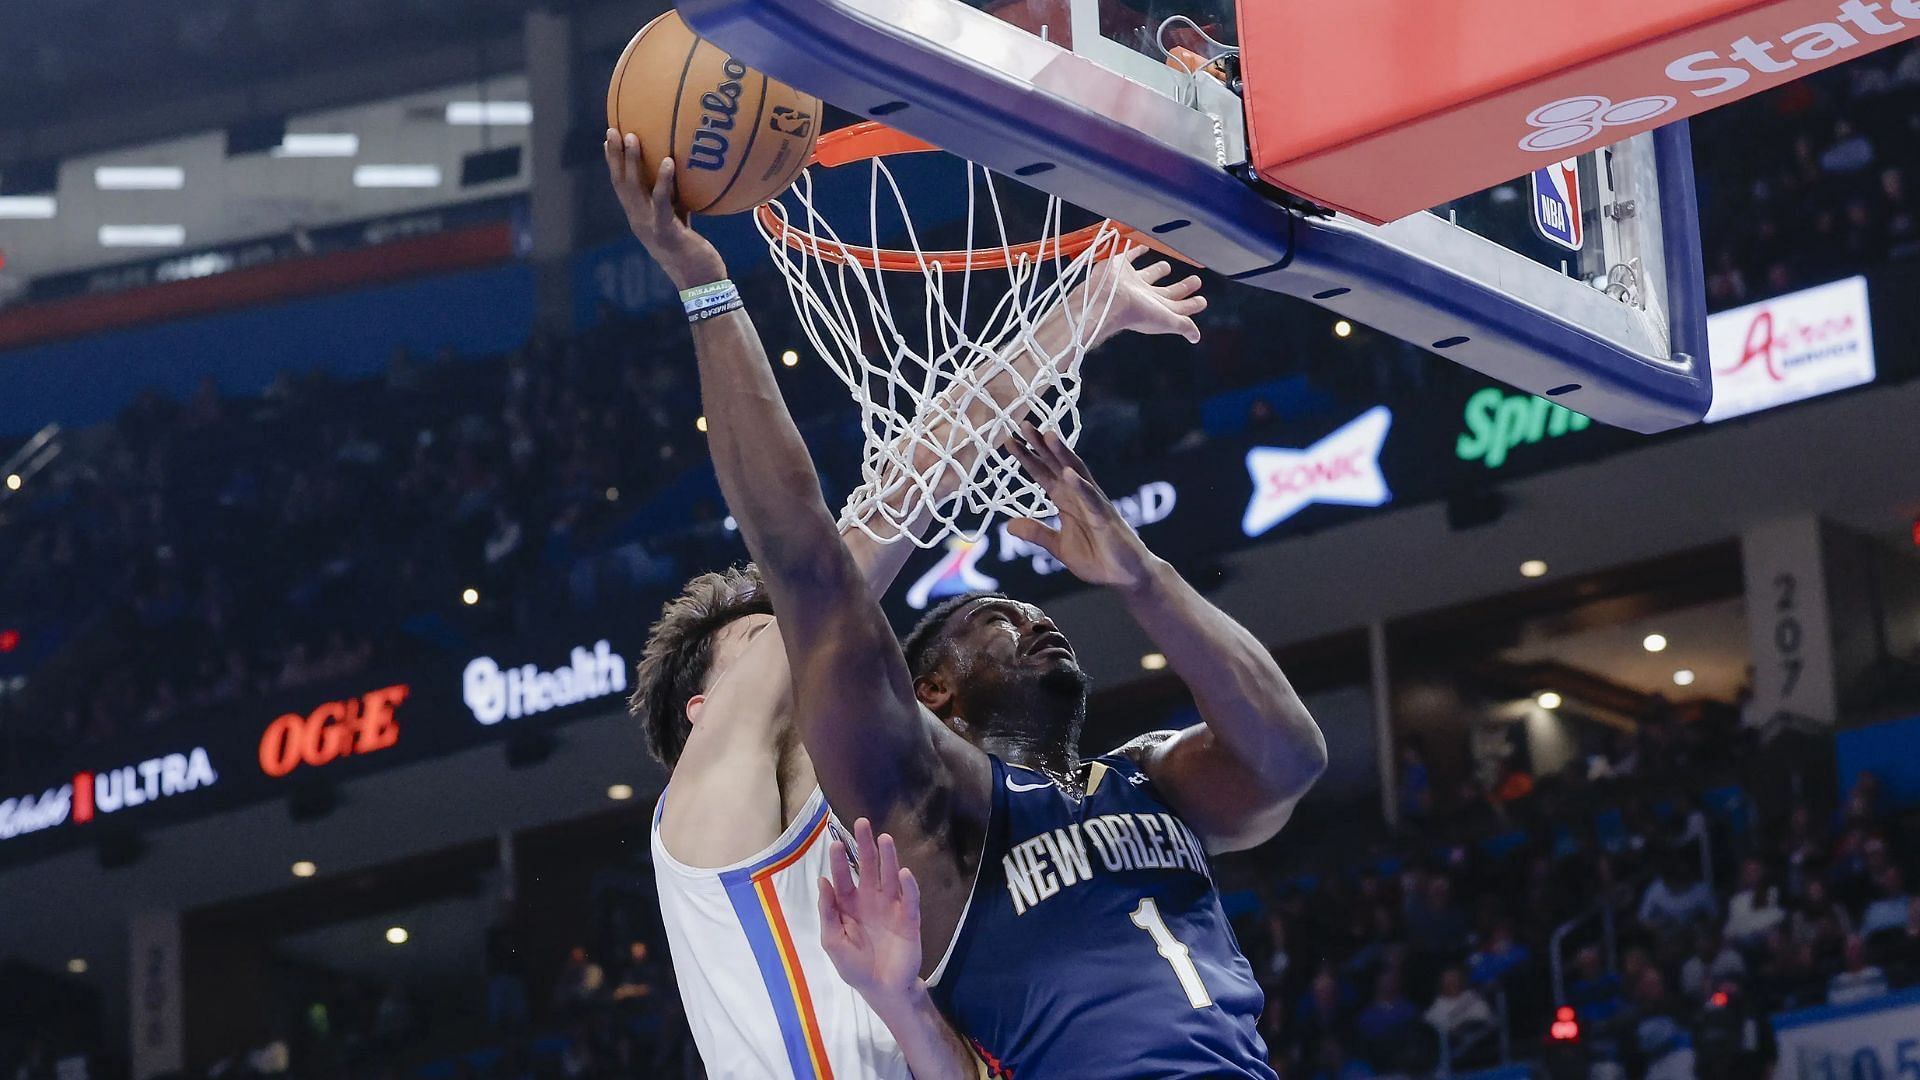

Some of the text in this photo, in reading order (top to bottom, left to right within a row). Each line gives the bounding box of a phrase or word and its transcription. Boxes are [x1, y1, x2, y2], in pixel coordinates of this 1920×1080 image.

[688, 54, 746, 171] Wilso
[1541, 195, 1566, 233] NBA
[1267, 448, 1365, 501] SONIC
[1456, 387, 1590, 469] Spri
[1774, 572, 1806, 698] 207
[94, 746, 218, 813] ULTRA
[1003, 813, 1212, 917] NEW ORLEAN
[1128, 897, 1213, 1009] 1
